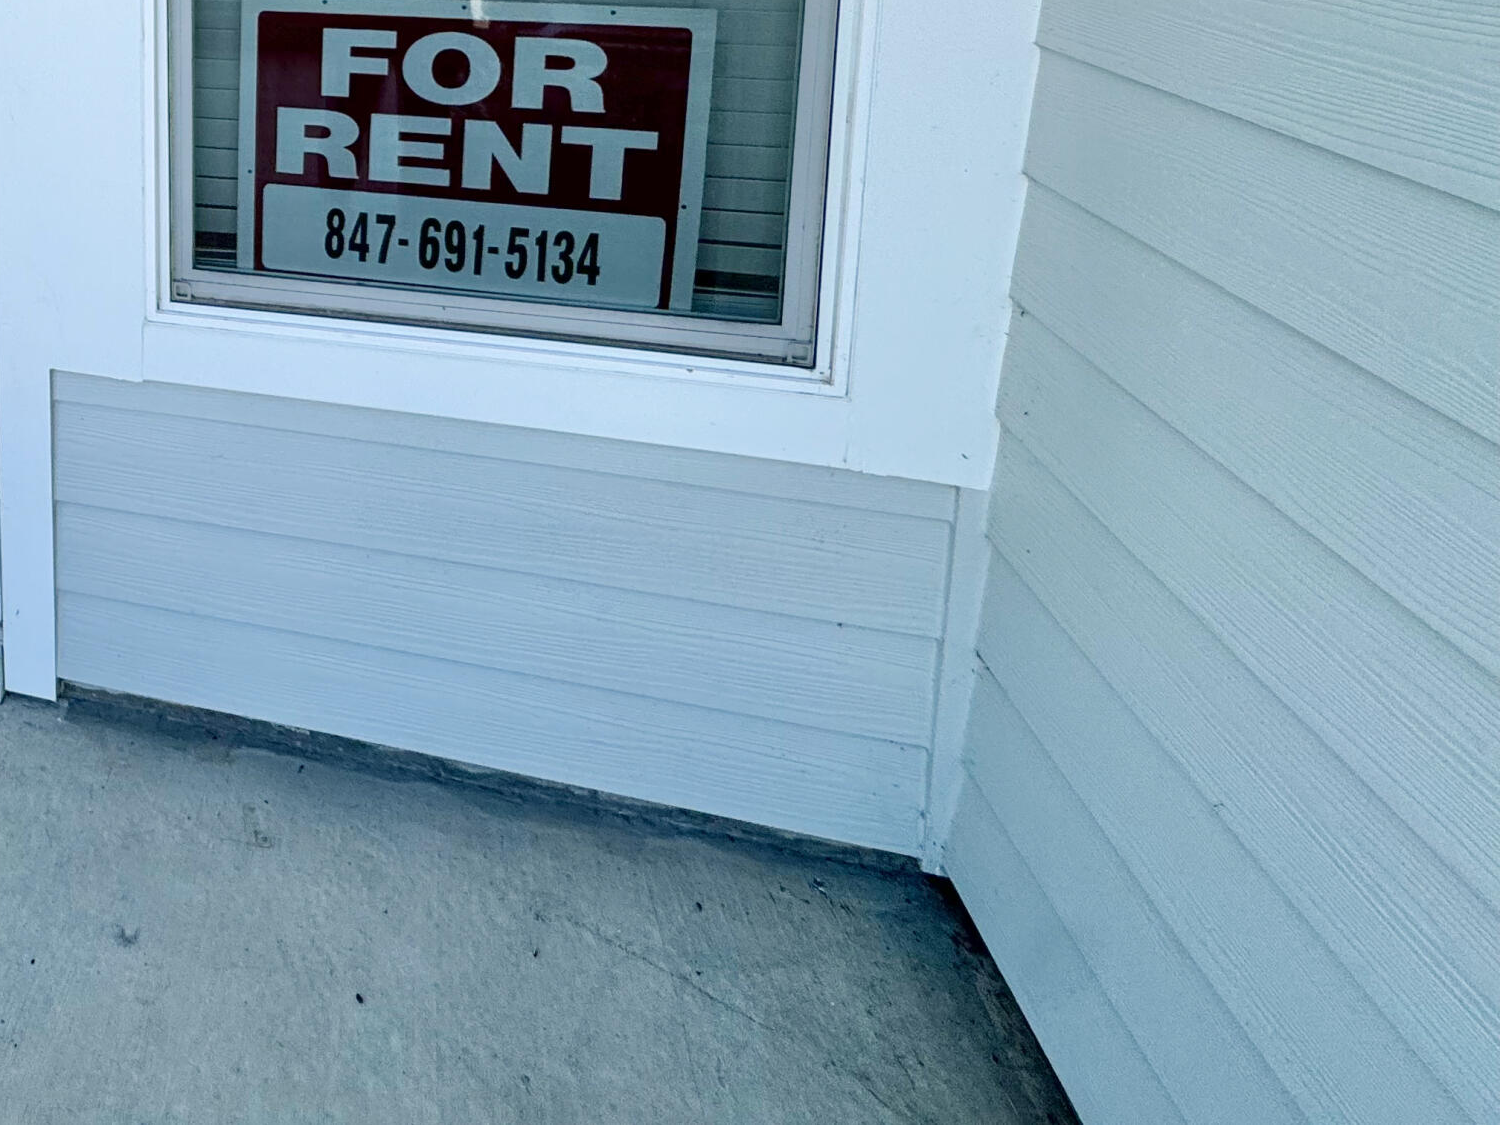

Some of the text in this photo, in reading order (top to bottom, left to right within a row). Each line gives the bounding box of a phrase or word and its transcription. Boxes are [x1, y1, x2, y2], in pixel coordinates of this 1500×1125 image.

[320, 27, 607, 114] FOR
[275, 106, 659, 201] RENT
[324, 208, 601, 286] 847-691-5134
